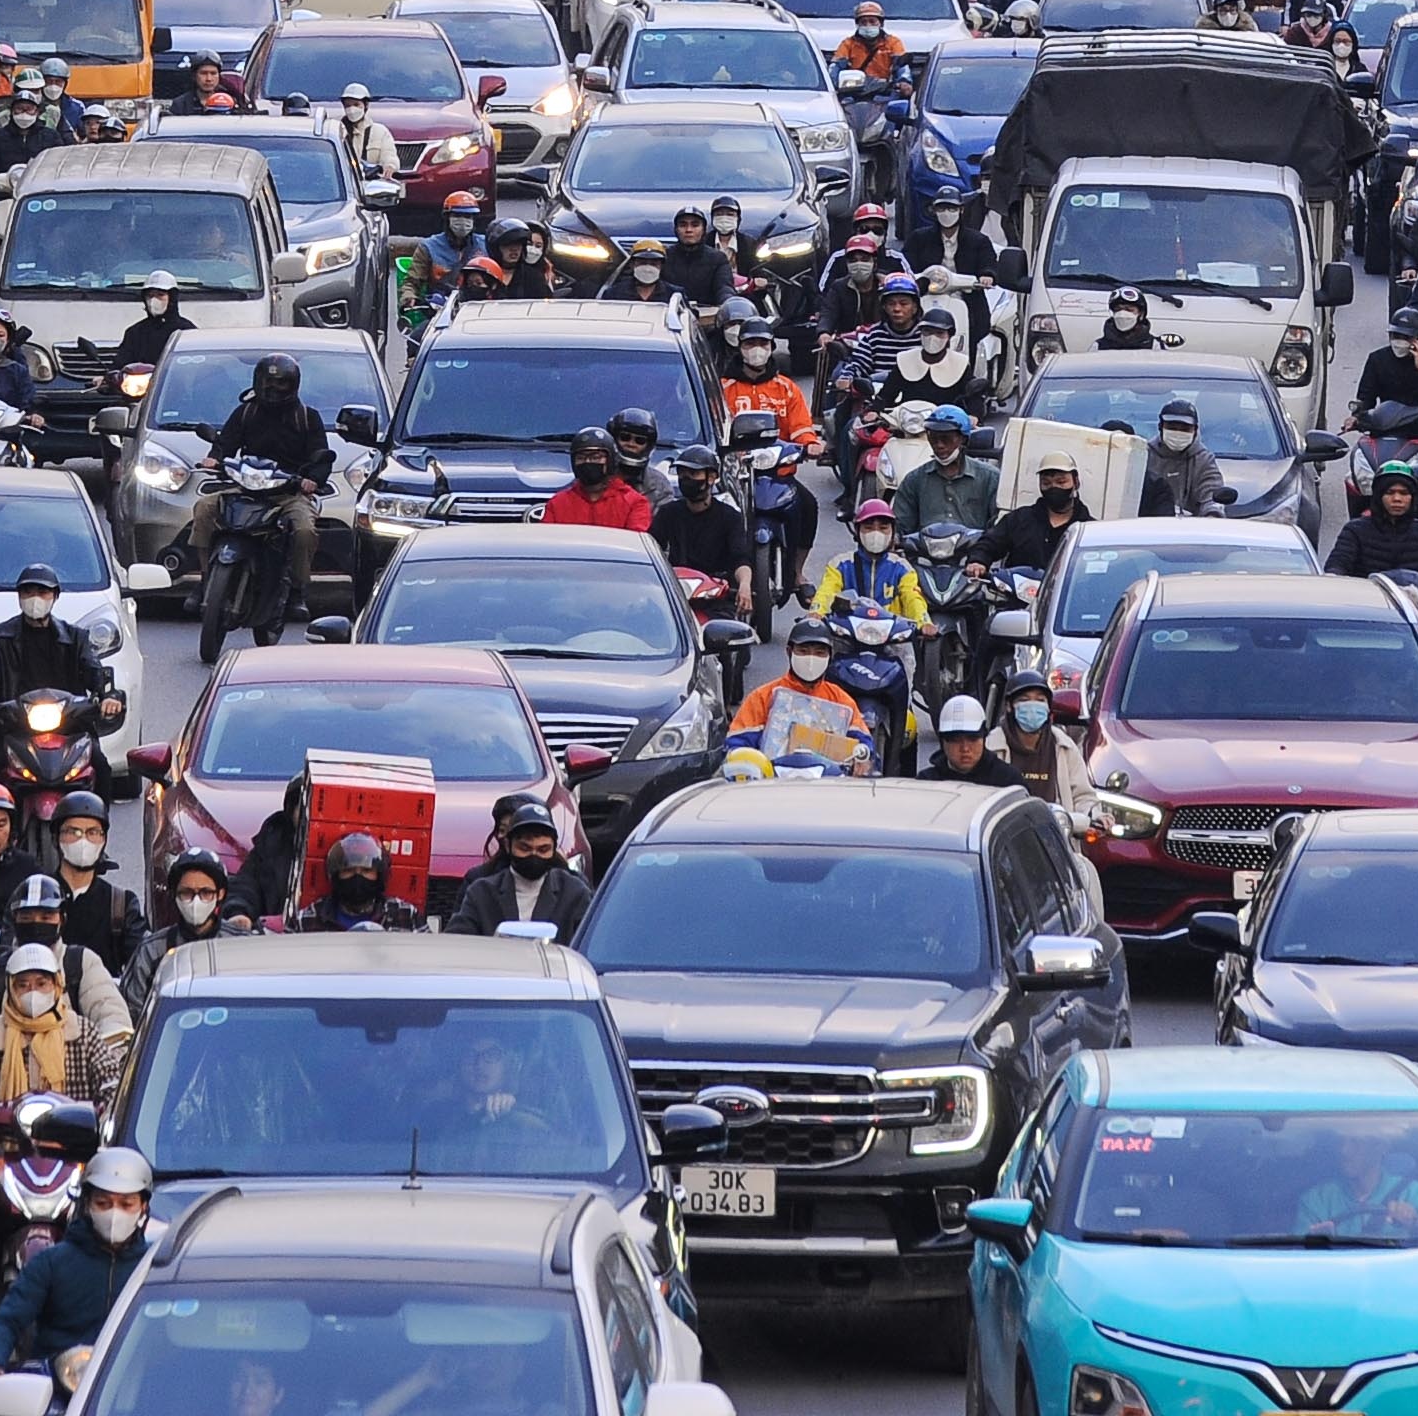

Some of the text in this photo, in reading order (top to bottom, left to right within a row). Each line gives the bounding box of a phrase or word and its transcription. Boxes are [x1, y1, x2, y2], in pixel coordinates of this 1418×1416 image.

[1102, 1137, 1153, 1152] TAXI
[708, 1170, 747, 1190] 30K
[691, 1192, 765, 1214] 034.83
